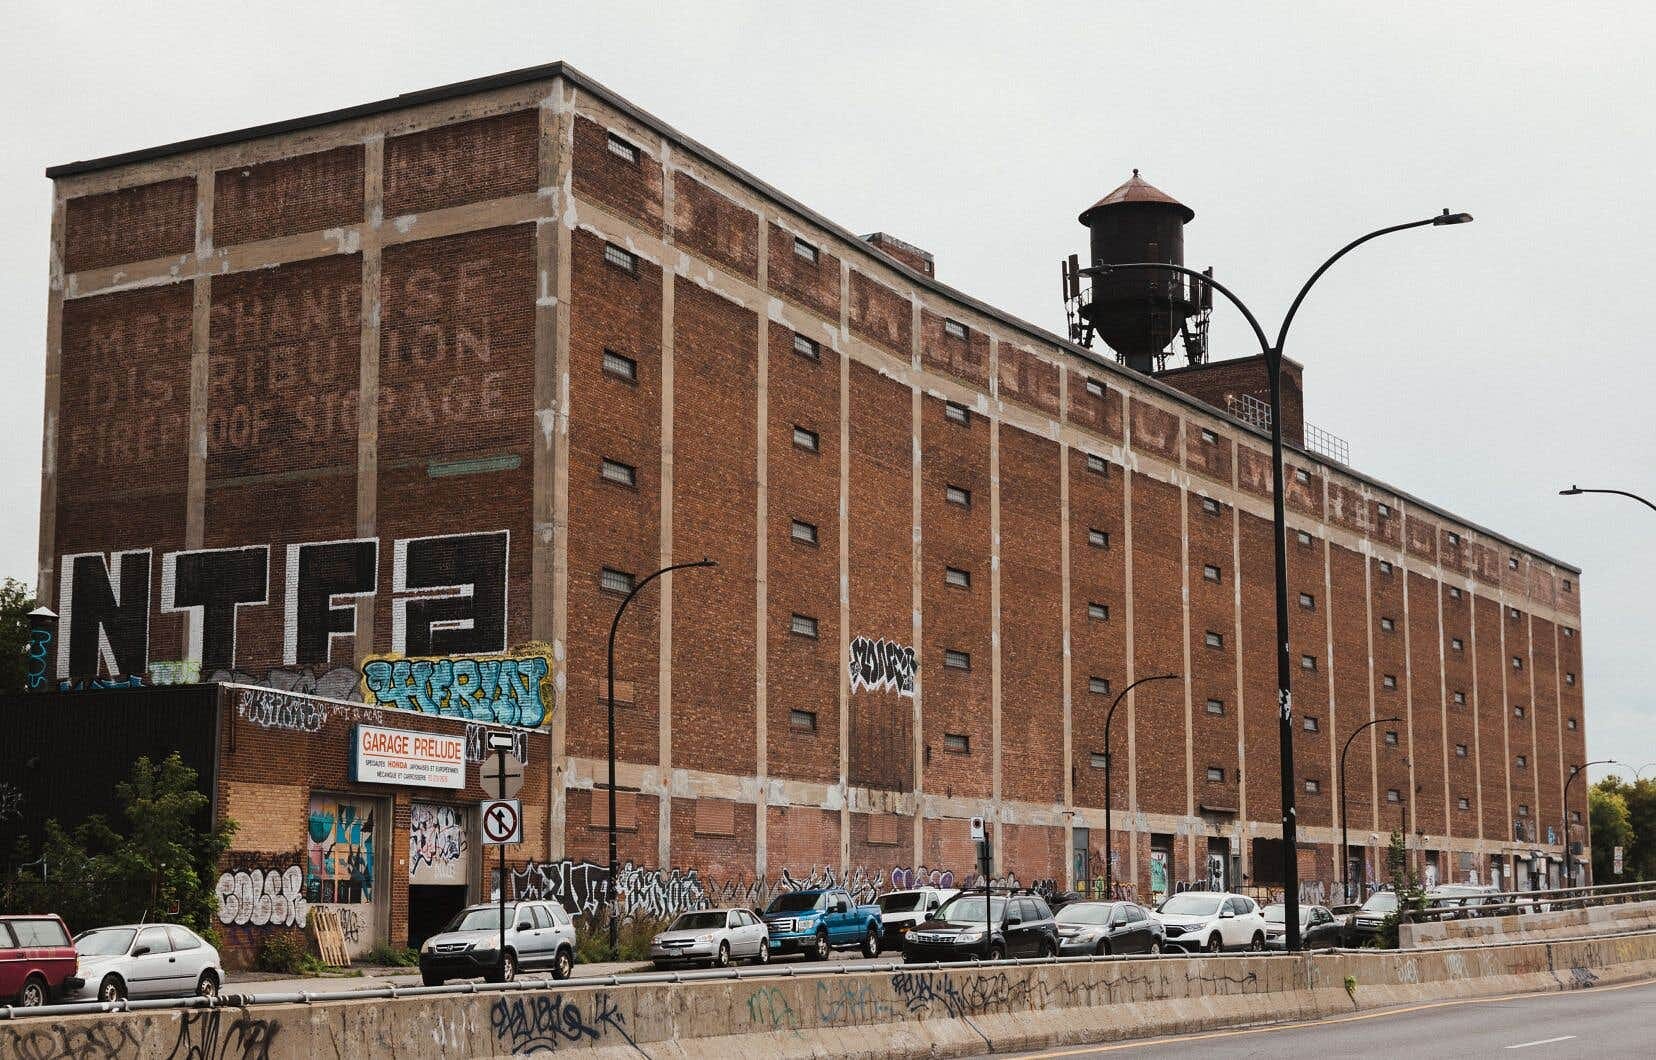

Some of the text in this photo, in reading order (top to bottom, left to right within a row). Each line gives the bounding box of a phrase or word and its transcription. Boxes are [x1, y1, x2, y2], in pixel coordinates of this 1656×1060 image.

[363, 731, 409, 755] GARAGE
[414, 737, 462, 760] PRELUDE
[387, 760, 408, 769] HONDA
